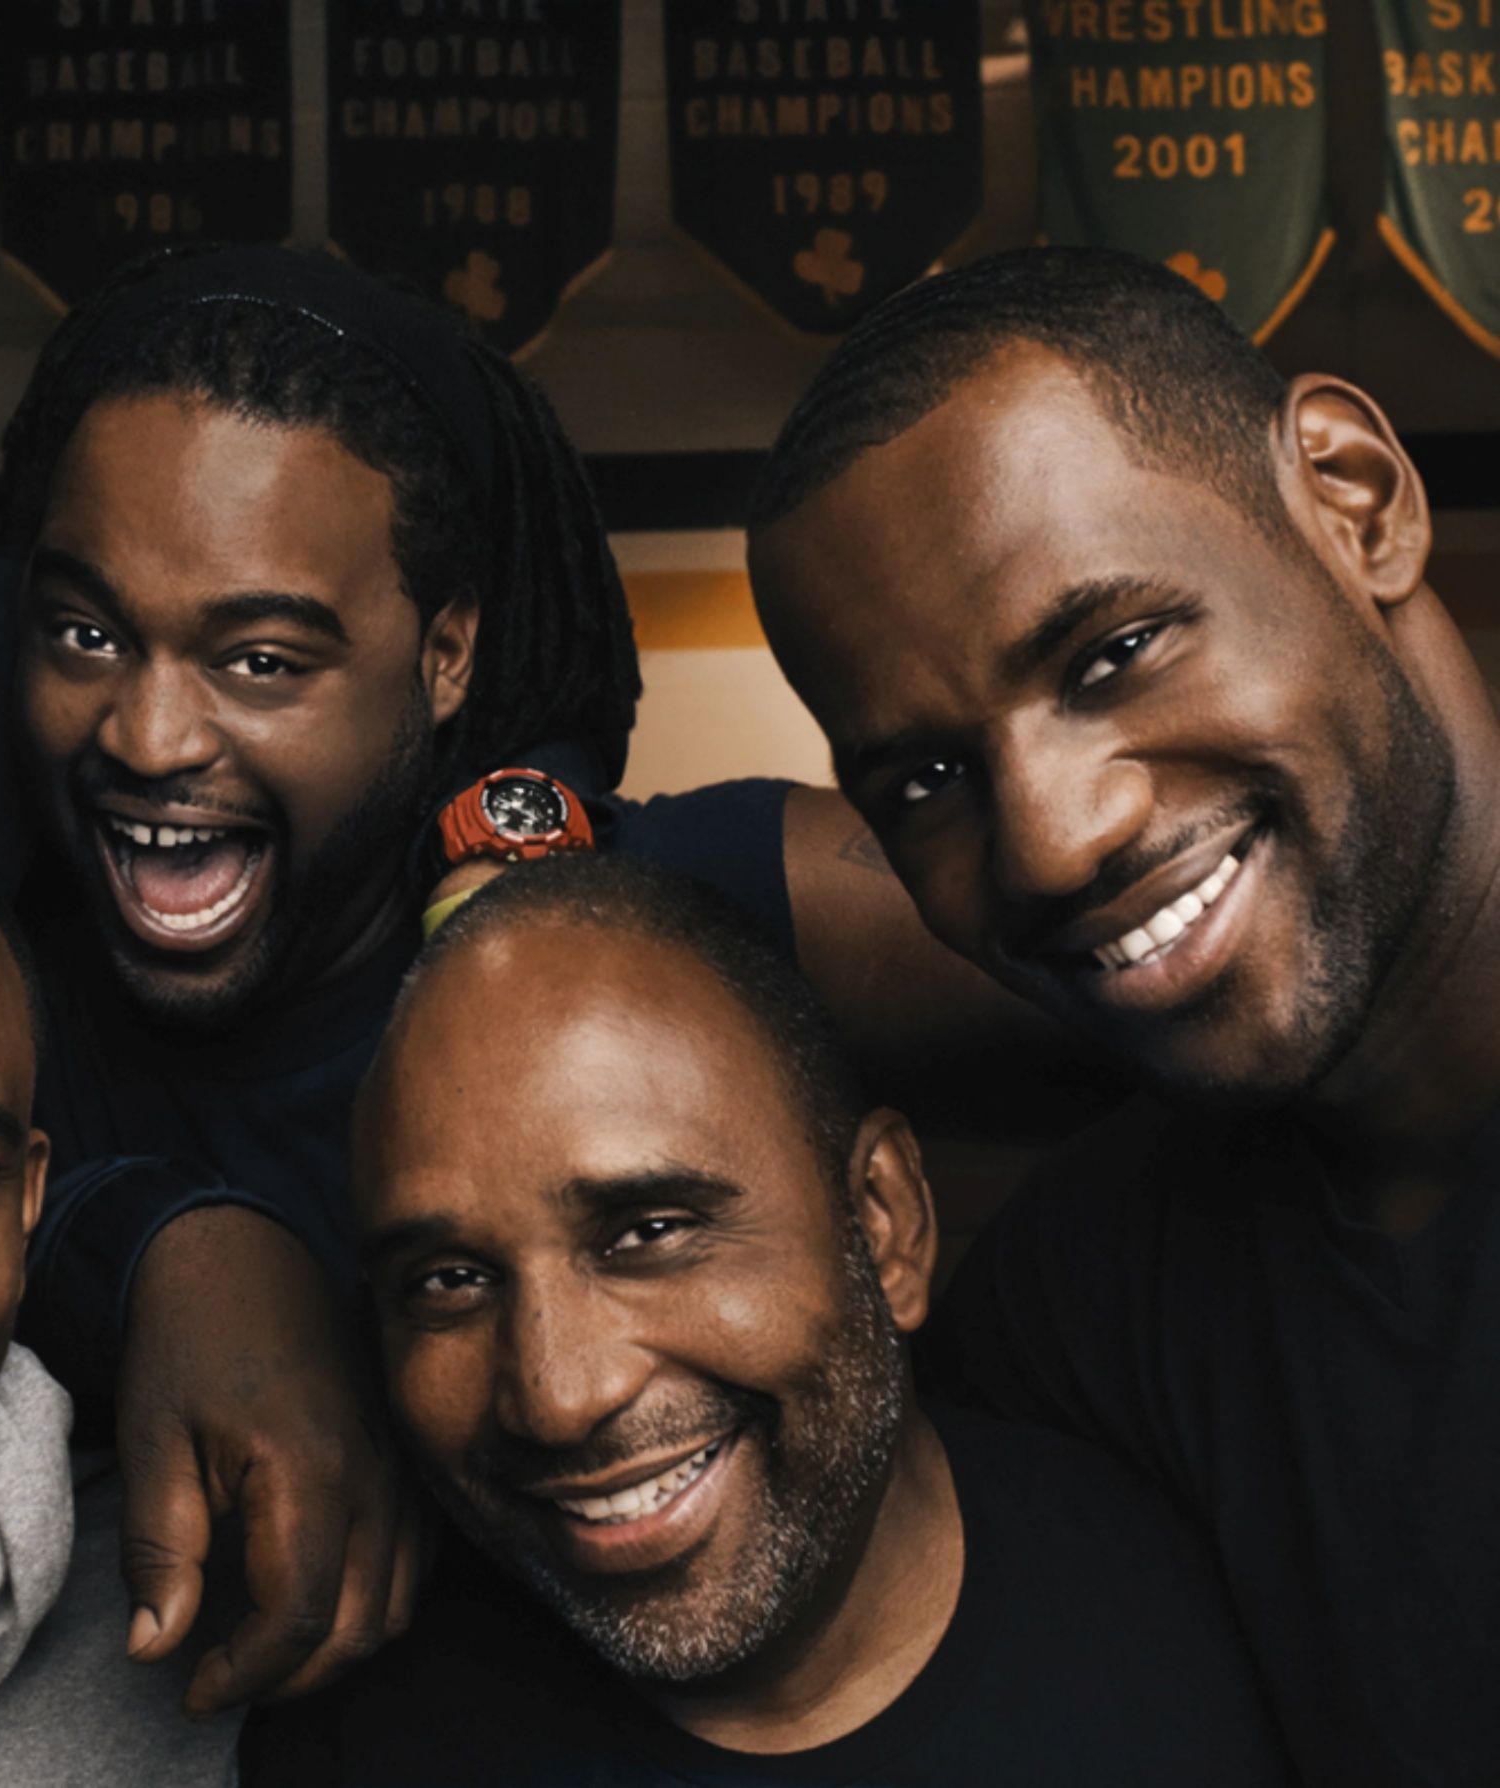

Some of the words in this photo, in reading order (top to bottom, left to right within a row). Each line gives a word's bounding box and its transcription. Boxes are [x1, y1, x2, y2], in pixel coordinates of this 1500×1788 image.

[26, 43, 244, 96] BASEBALL
[353, 33, 576, 79] FOOTBALL
[694, 34, 944, 81] BASEBALL
[1069, 60, 1317, 110] HAMPIONS
[341, 94, 589, 141] CHAMPIONS
[685, 91, 955, 138] CHAMPIONS
[13, 114, 282, 164] CHAMPIONS
[1112, 131, 1247, 179] 2001
[1396, 117, 1500, 167] CHA
[422, 181, 533, 229] 1988
[772, 169, 888, 216] 1989
[1462, 185, 1500, 235] 2
